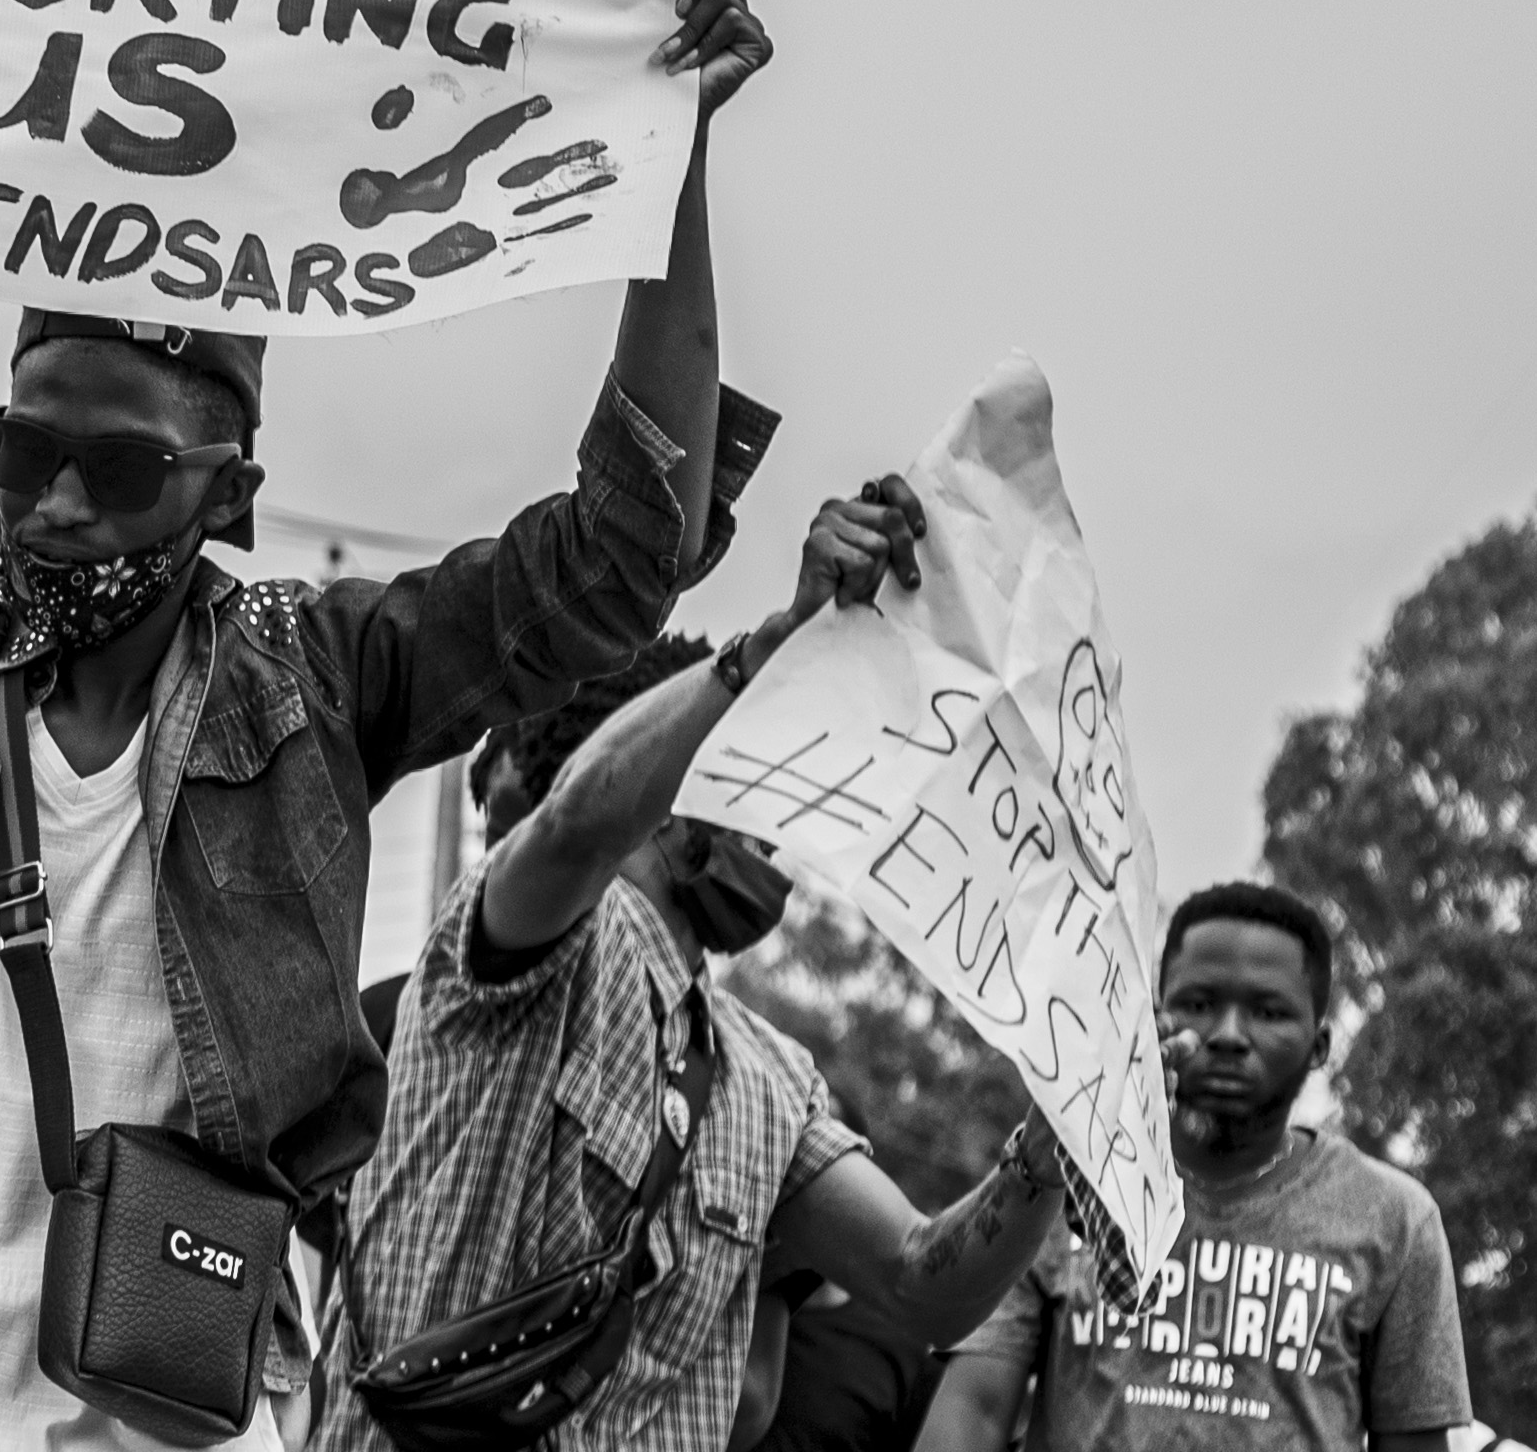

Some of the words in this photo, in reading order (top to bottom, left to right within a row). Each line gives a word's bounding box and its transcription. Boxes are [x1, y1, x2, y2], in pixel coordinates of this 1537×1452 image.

[881, 690, 1056, 872] STOP
[170, 1229, 244, 1280] C-zar
[1168, 1357, 1234, 1389] JEANS
